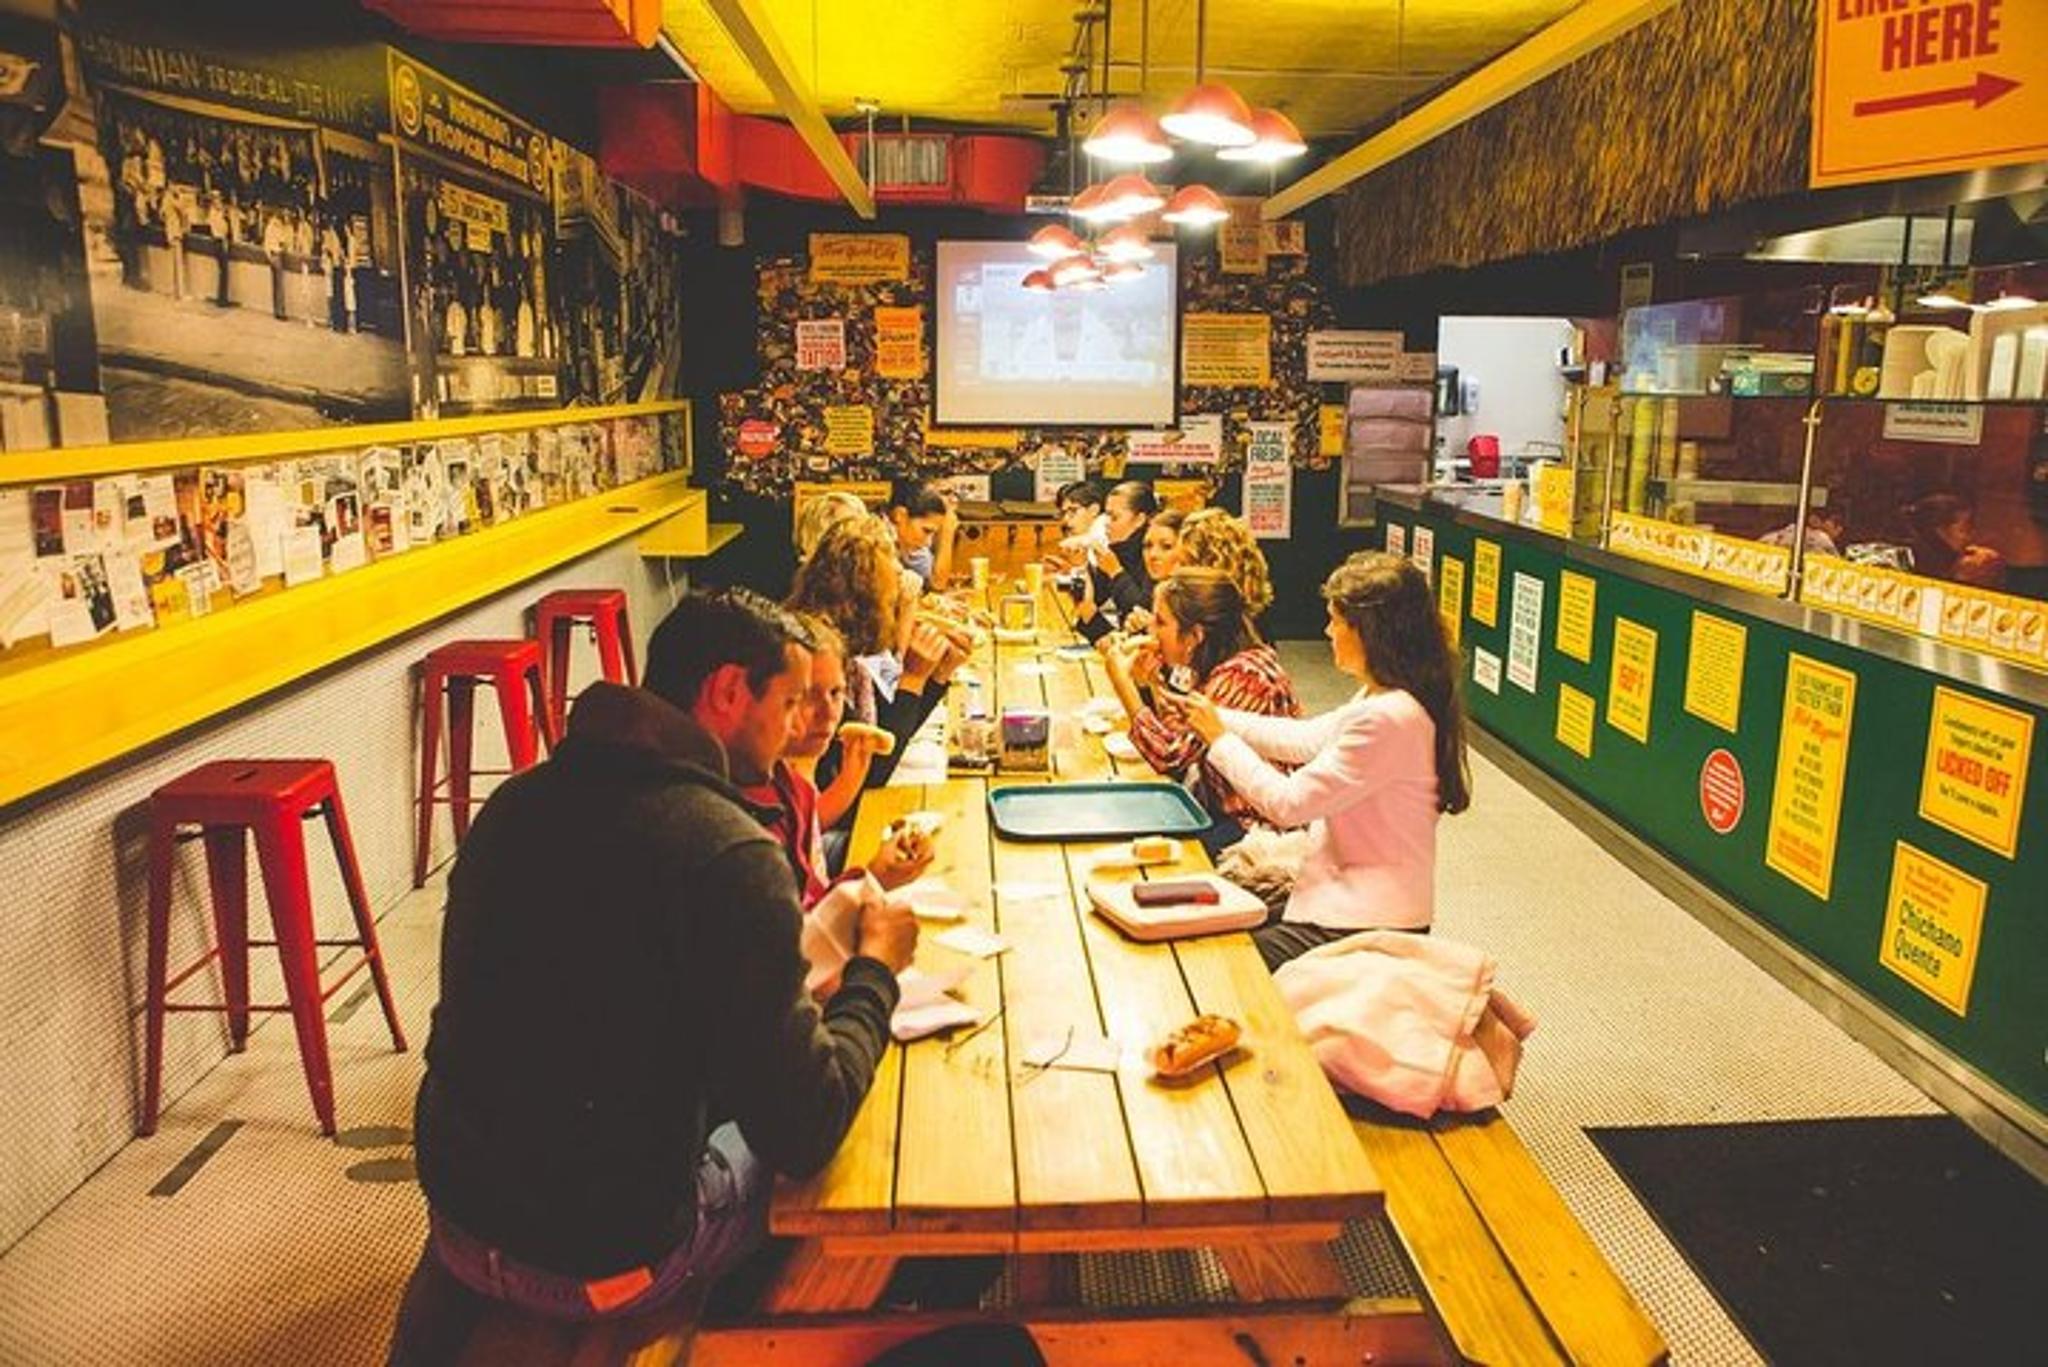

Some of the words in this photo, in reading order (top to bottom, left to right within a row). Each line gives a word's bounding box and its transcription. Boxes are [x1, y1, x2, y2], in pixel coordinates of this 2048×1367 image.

[1881, 0, 2000, 71] HERE
[423, 112, 490, 164] TROPICAL
[1255, 429, 1284, 444] OCAL
[1937, 746, 1984, 788] LICKED
[1984, 766, 2012, 798] OFF
[1893, 926, 1942, 979] Quente
